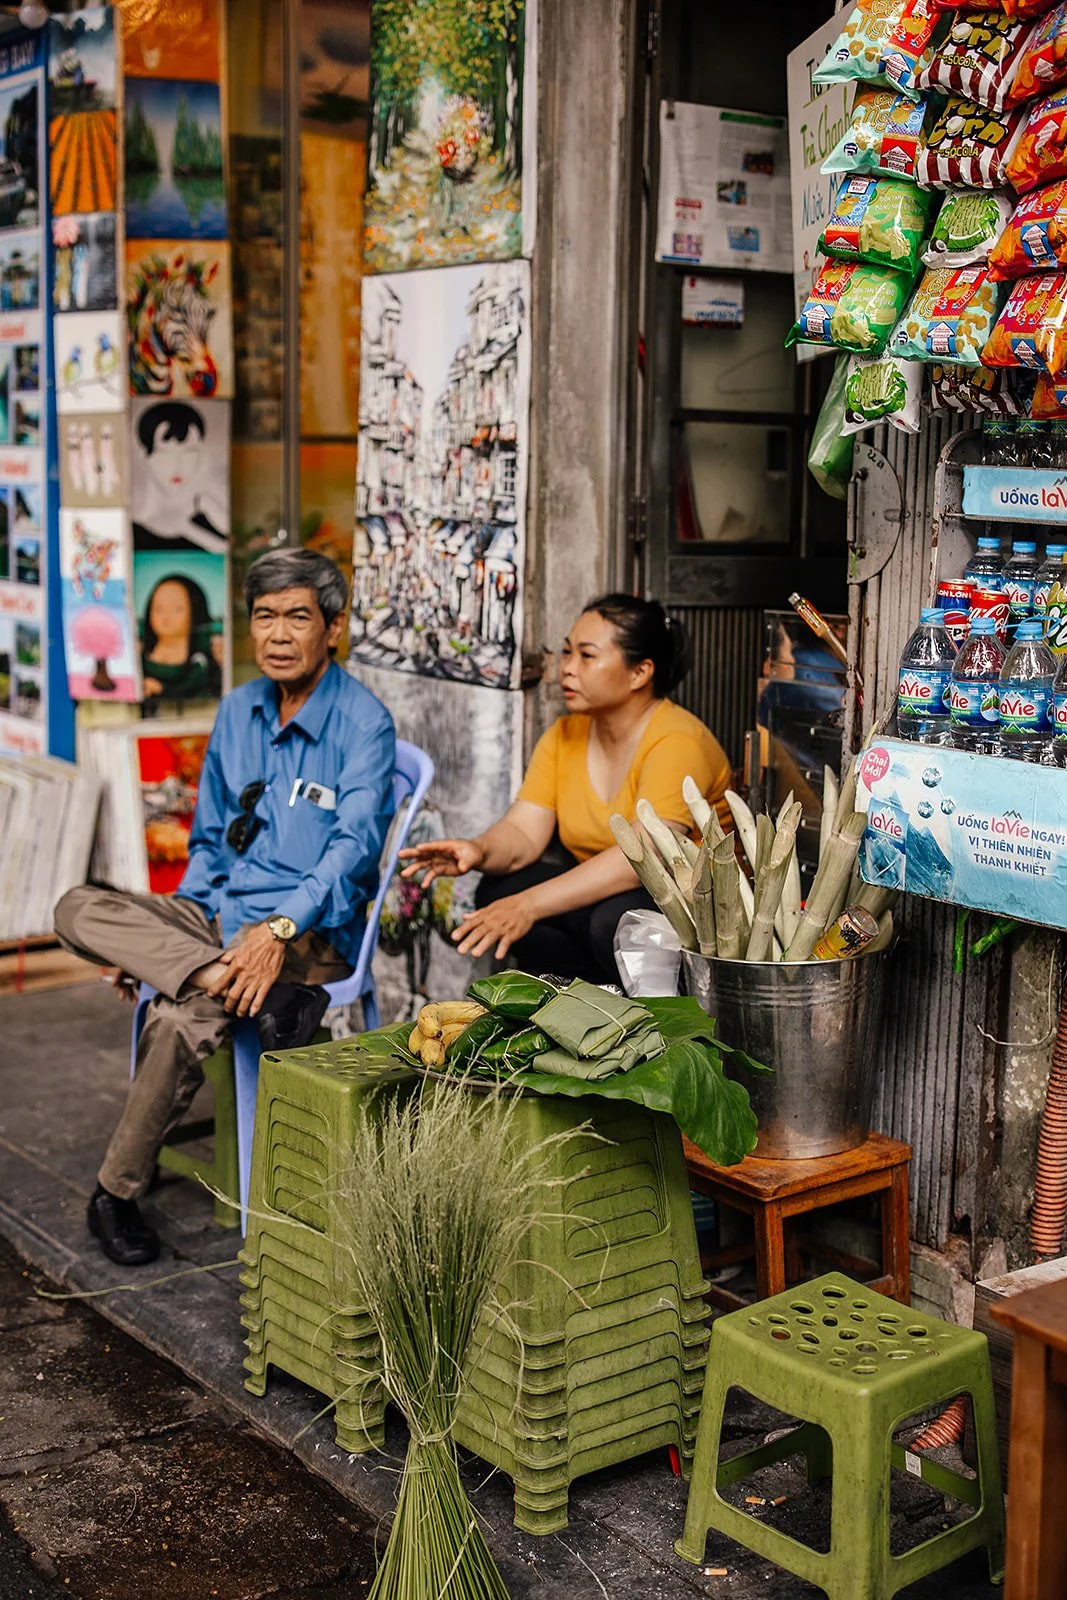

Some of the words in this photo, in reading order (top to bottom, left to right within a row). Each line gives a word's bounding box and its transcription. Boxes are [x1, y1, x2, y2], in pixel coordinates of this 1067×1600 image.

[801, 124, 817, 165] Trà
[1000, 487, 1039, 506] UỐNG
[1041, 486, 1067, 508] laV
[1005, 588, 1029, 603] Vie
[899, 680, 931, 698] aVie
[951, 691, 969, 709] Vie
[1000, 698, 1035, 716] aVie
[867, 751, 889, 767] Chai
[864, 764, 883, 778] Mới
[869, 811, 903, 837] laVie
[957, 814, 989, 831] UỐNG
[991, 817, 1030, 838] laVie
[1031, 829, 1066, 846] NGAY!
[968, 836, 979, 849] VỊ
[982, 838, 1014, 854] THIÊN
[1017, 845, 1051, 861] NHIÊN
[974, 853, 1011, 870] THANH
[1014, 861, 1047, 876] KHIẾT
